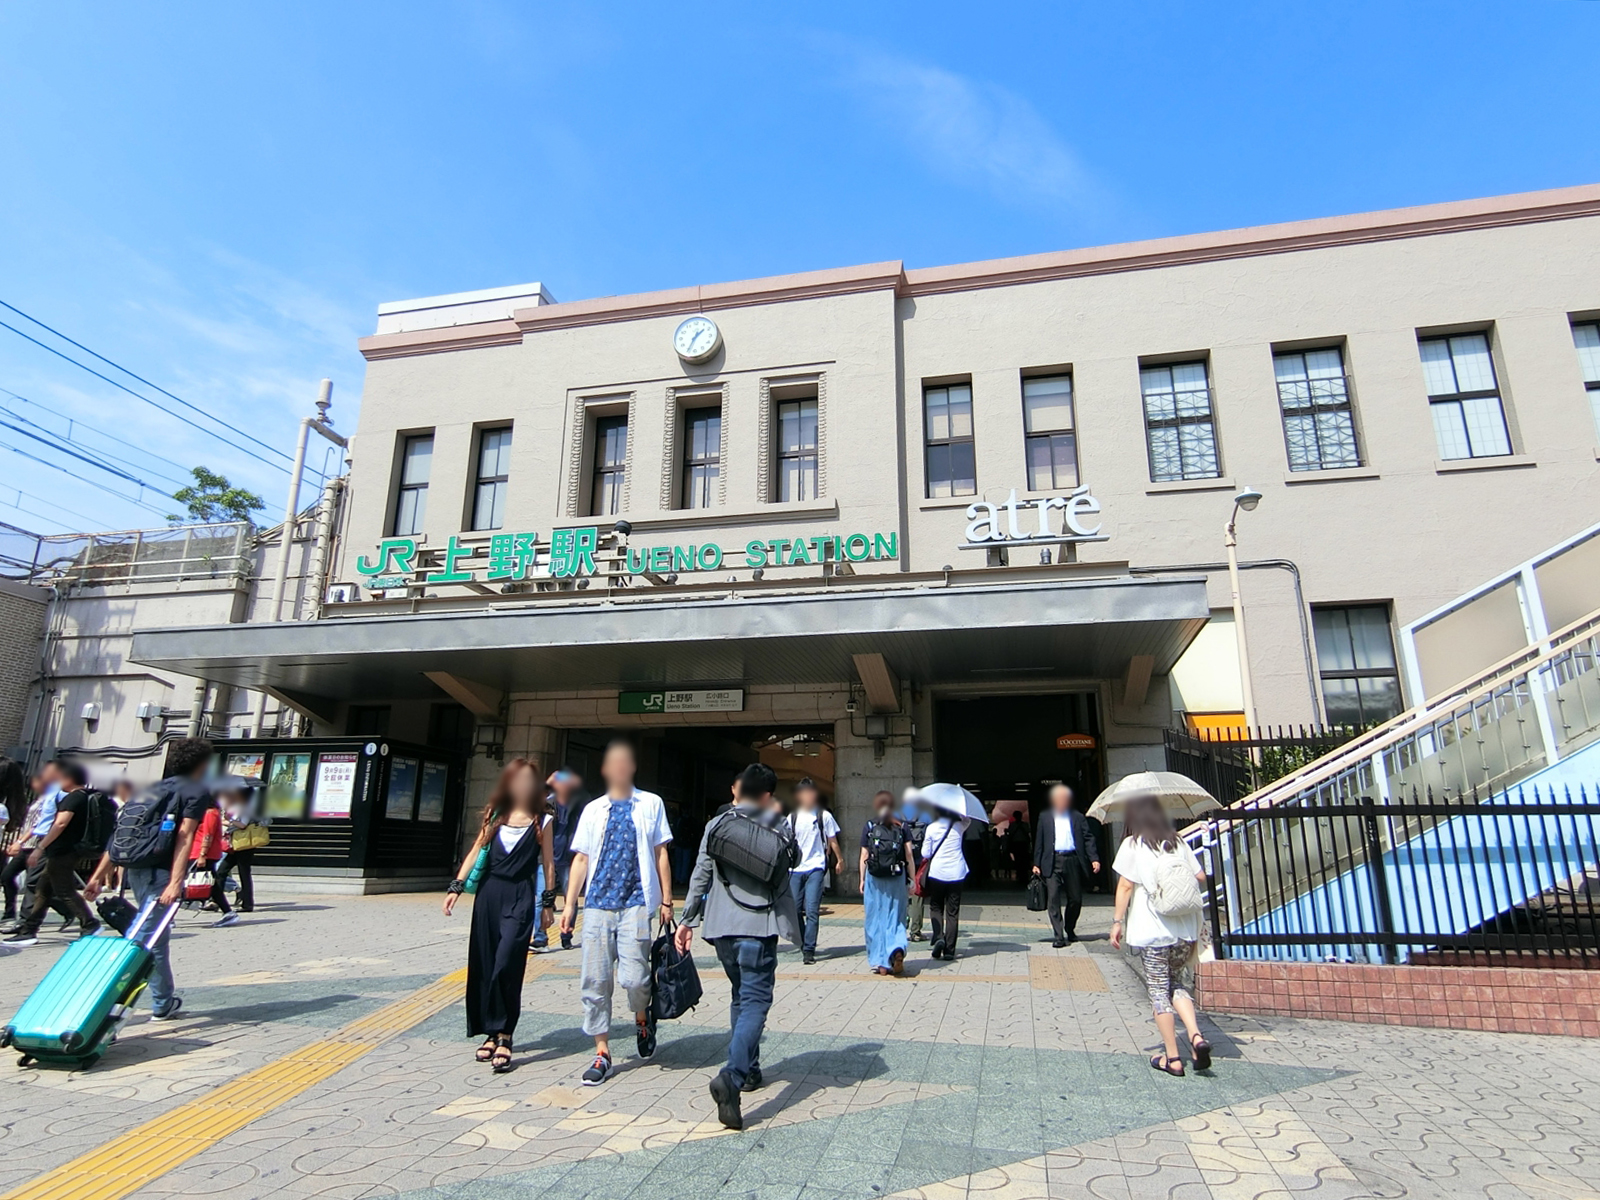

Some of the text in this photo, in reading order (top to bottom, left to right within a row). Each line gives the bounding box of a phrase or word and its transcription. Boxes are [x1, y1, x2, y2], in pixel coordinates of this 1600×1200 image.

[964, 484, 1102, 544] atré
[356, 527, 899, 583] JR 上野駅 UENO STATION
[643, 694, 663, 706] JR
[667, 693, 693, 703] 上野駅
